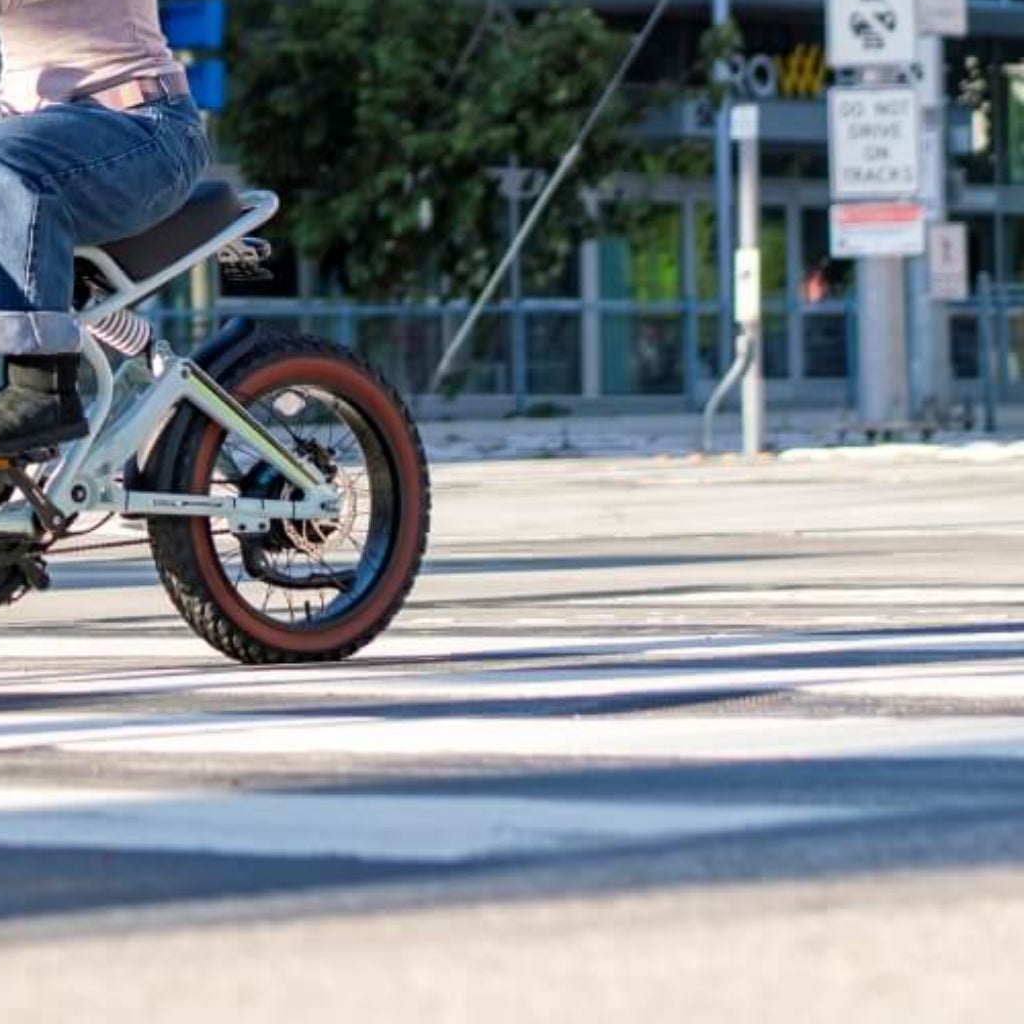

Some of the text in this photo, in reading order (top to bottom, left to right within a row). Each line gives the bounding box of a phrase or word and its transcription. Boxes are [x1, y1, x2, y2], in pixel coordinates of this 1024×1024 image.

[841, 98, 909, 116] DO NOT
[847, 122, 902, 139] DRIVE
[864, 146, 889, 162] ON
[843, 166, 914, 184] TRACKS
